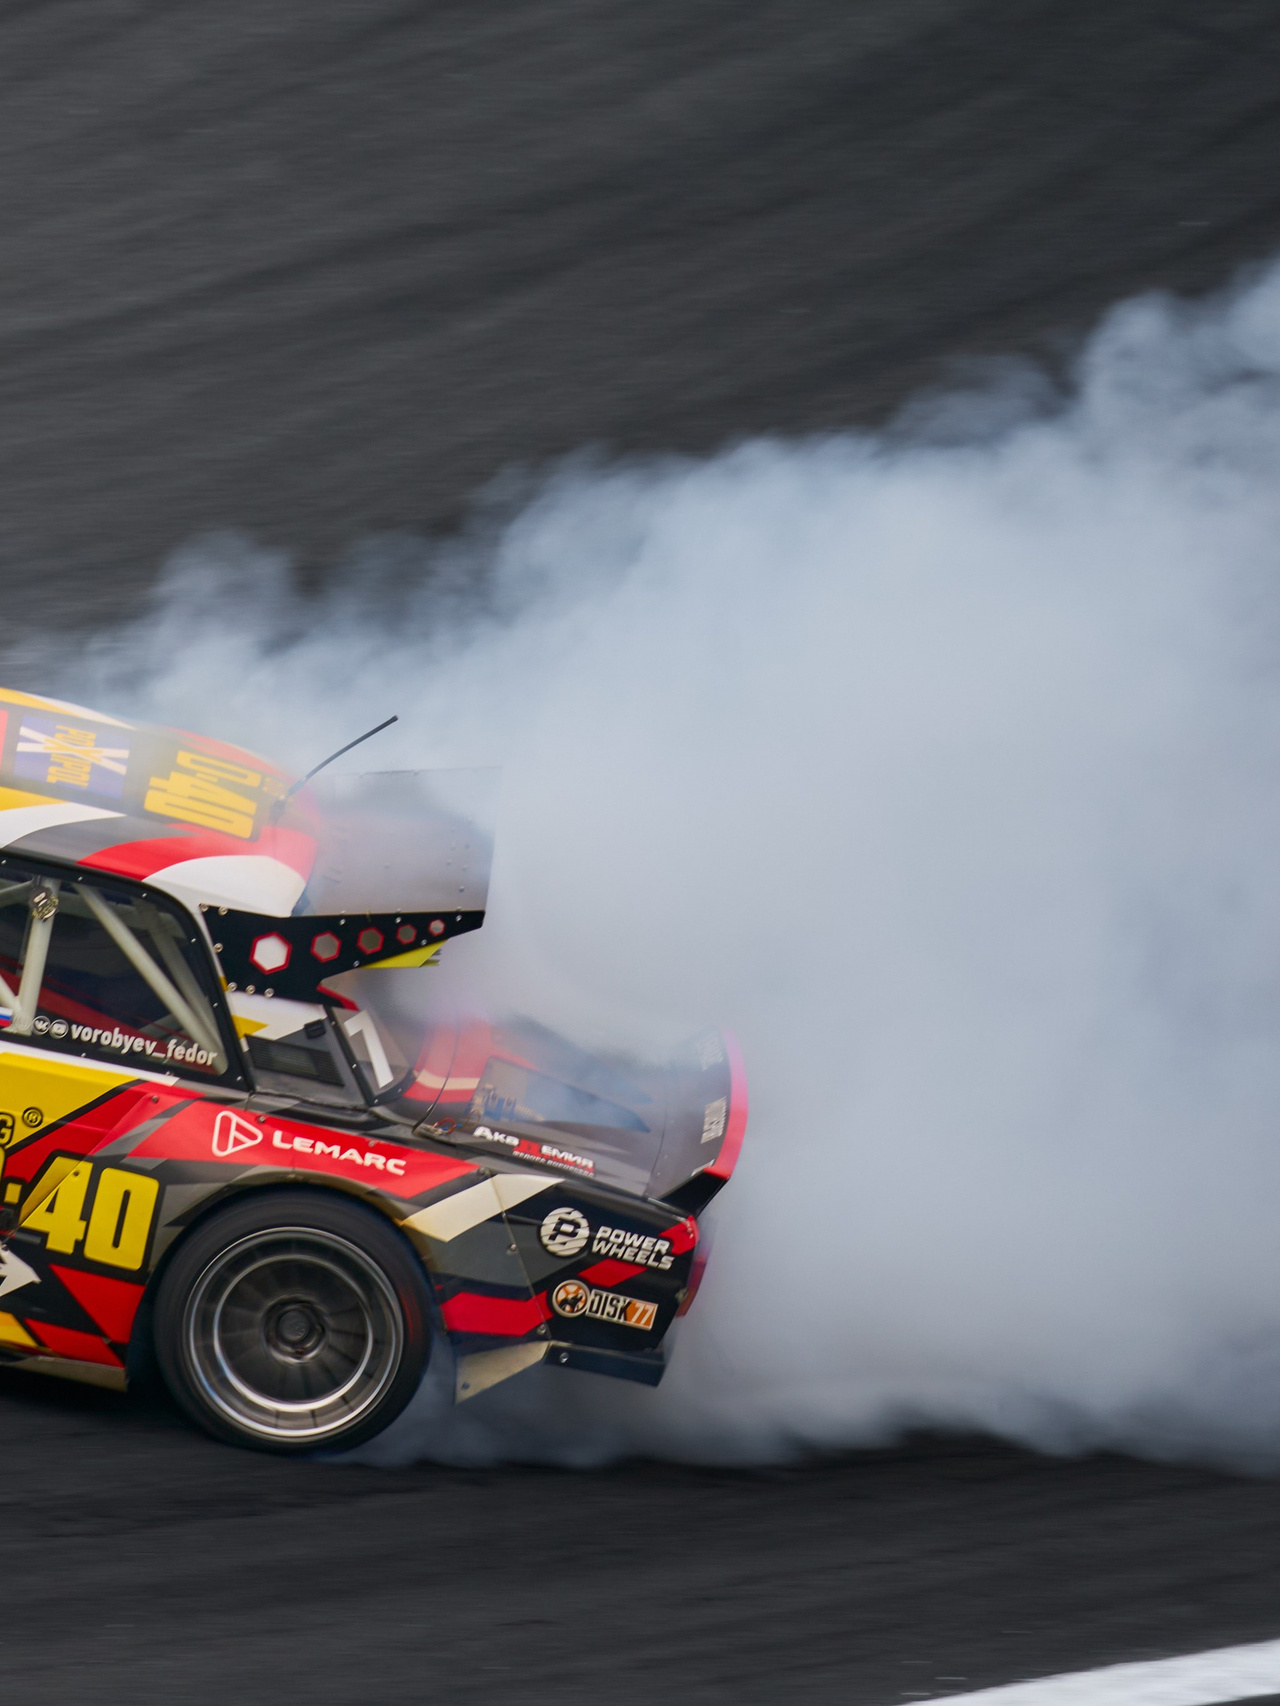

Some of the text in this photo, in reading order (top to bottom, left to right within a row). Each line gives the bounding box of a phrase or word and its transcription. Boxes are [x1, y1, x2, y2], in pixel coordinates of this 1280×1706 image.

[43, 725, 104, 790] POXIPOL
[71, 1024, 217, 1066] vorobyev_fedor
[272, 1130, 407, 1176] LEMARC
[591, 1239, 675, 1271] WHEELS
[595, 1225, 670, 1255] POWER
